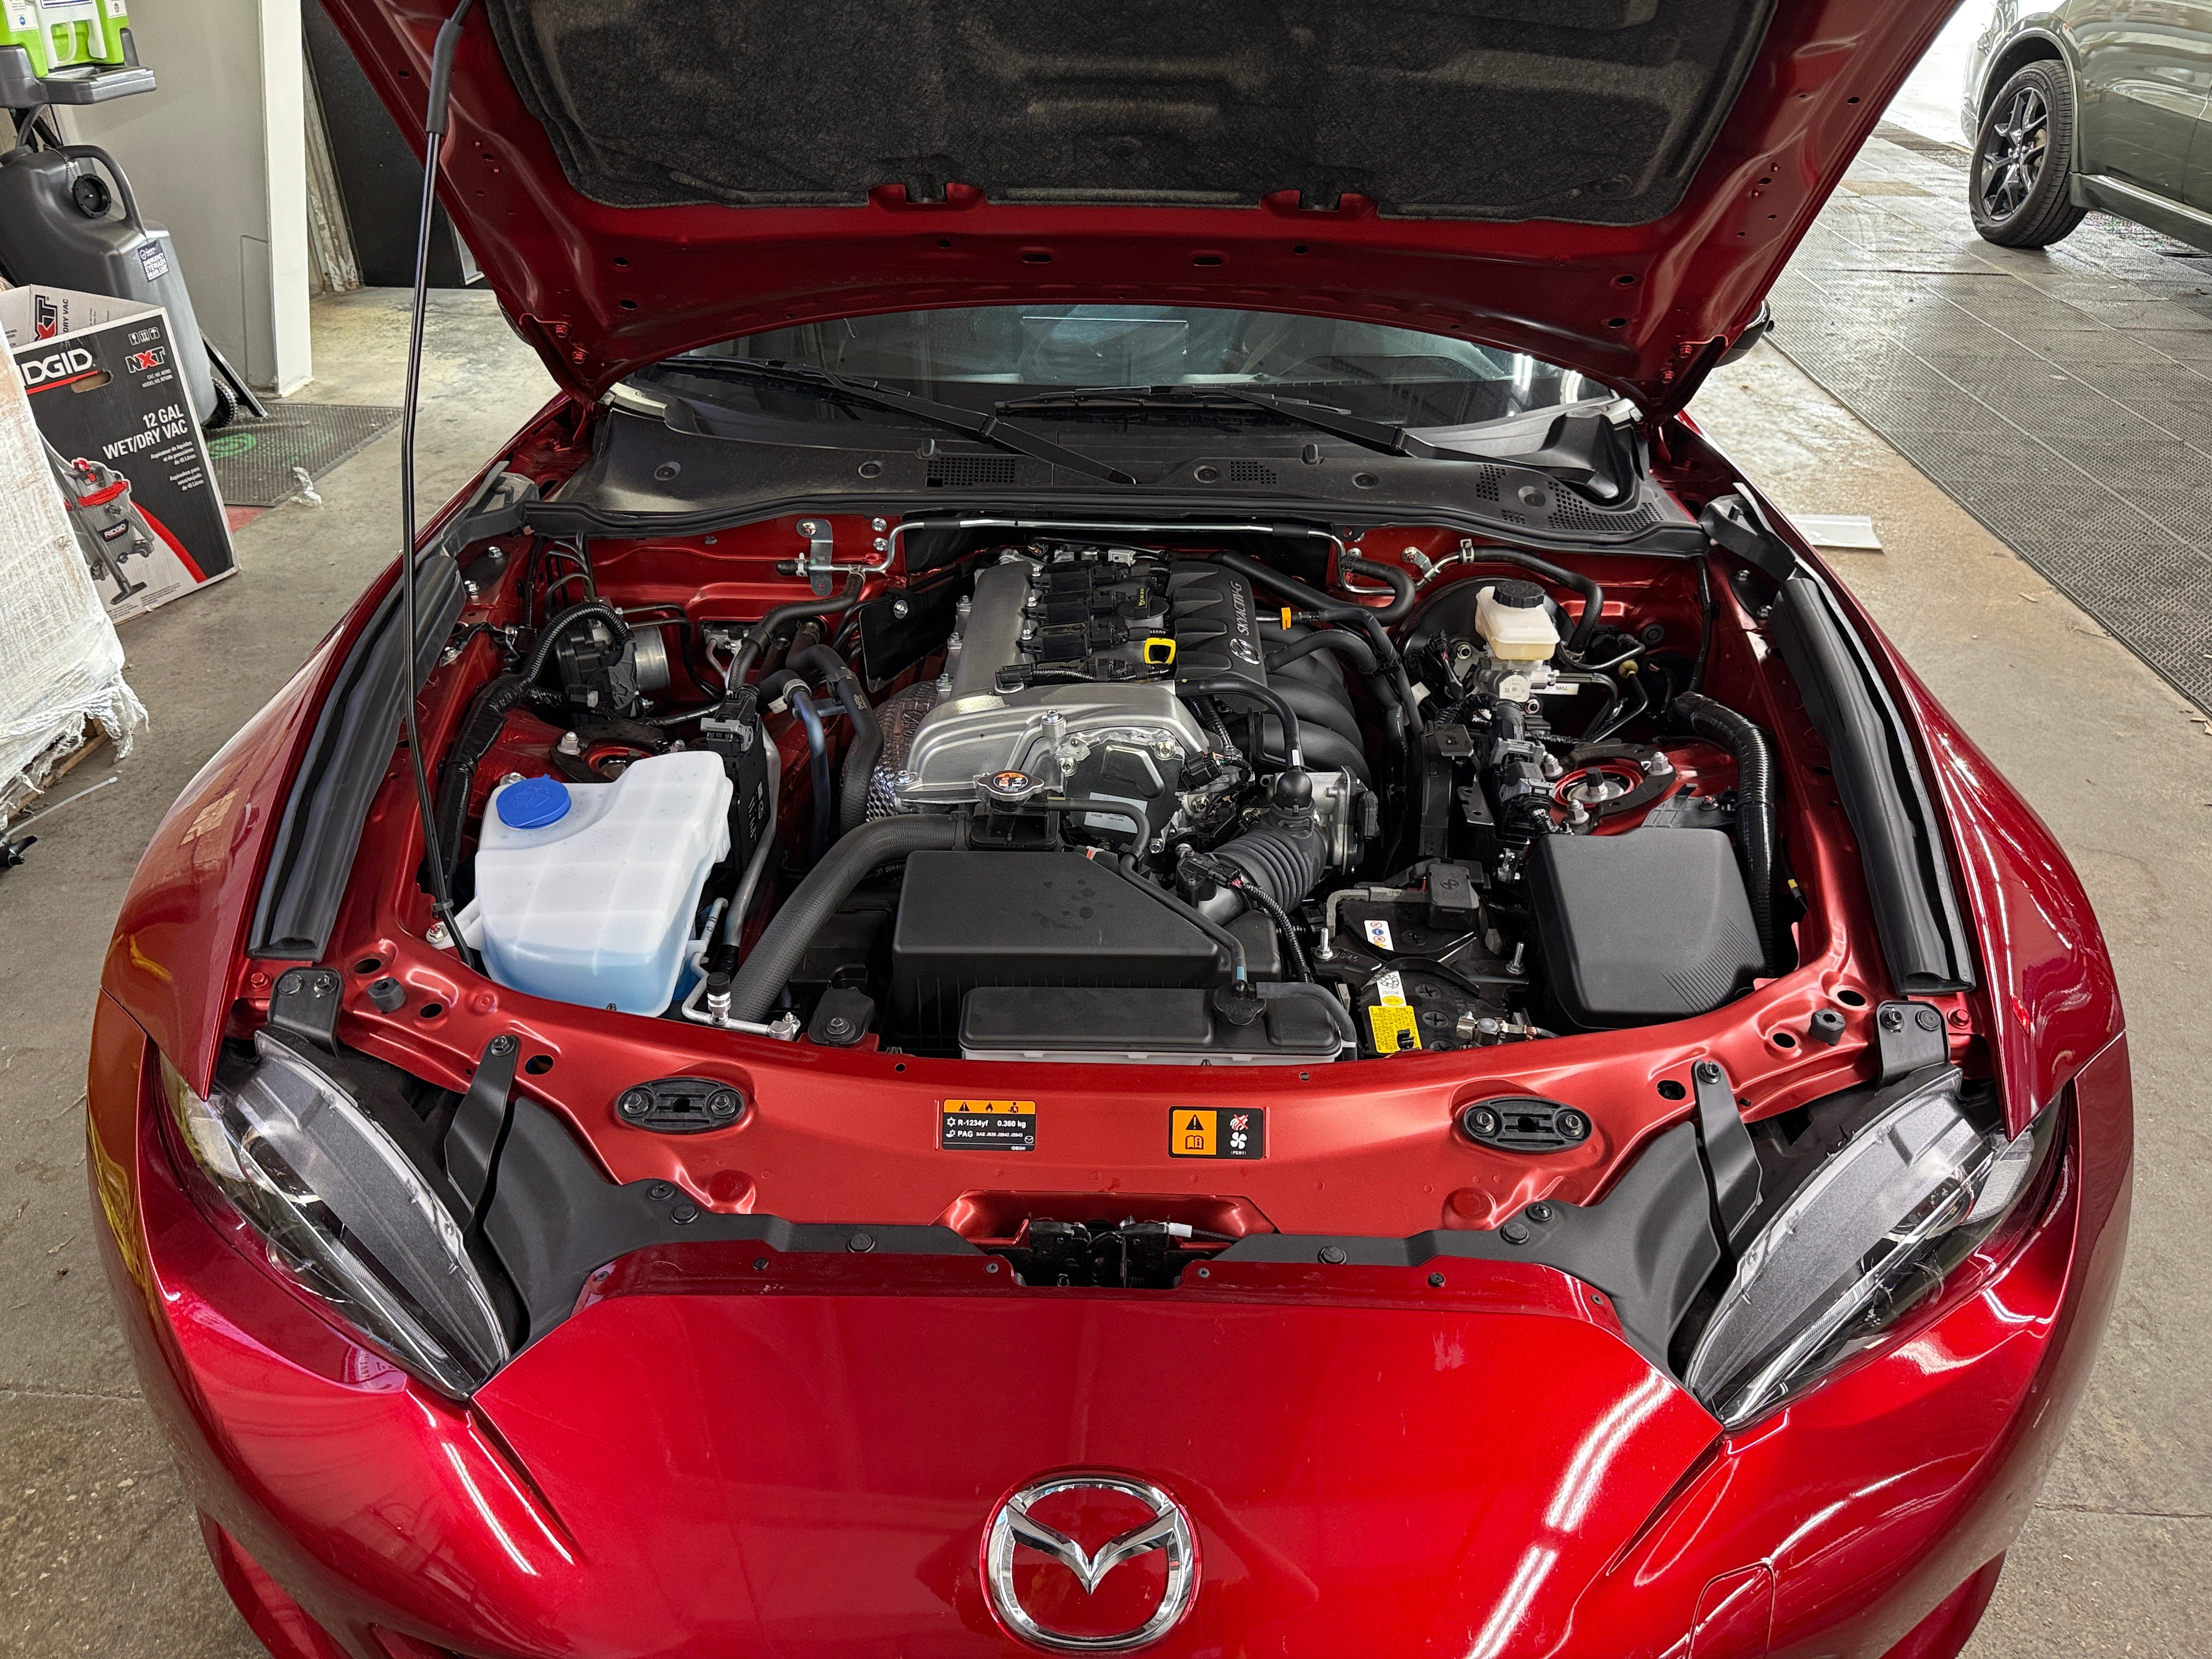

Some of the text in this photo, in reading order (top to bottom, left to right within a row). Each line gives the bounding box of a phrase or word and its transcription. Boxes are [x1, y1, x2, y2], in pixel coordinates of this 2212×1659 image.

[143, 252, 164, 267] EMERGENCY
[145, 258, 166, 273] EYEWASH
[18, 348, 93, 386] IDGID
[125, 346, 165, 374] NXT
[143, 403, 184, 429] 12 GAL
[102, 419, 188, 460] WET/DRY VAC
[104, 523, 126, 539] RIDGID
[957, 1119, 989, 1128] R-1234yf
[1017, 1120, 1026, 1129] kg
